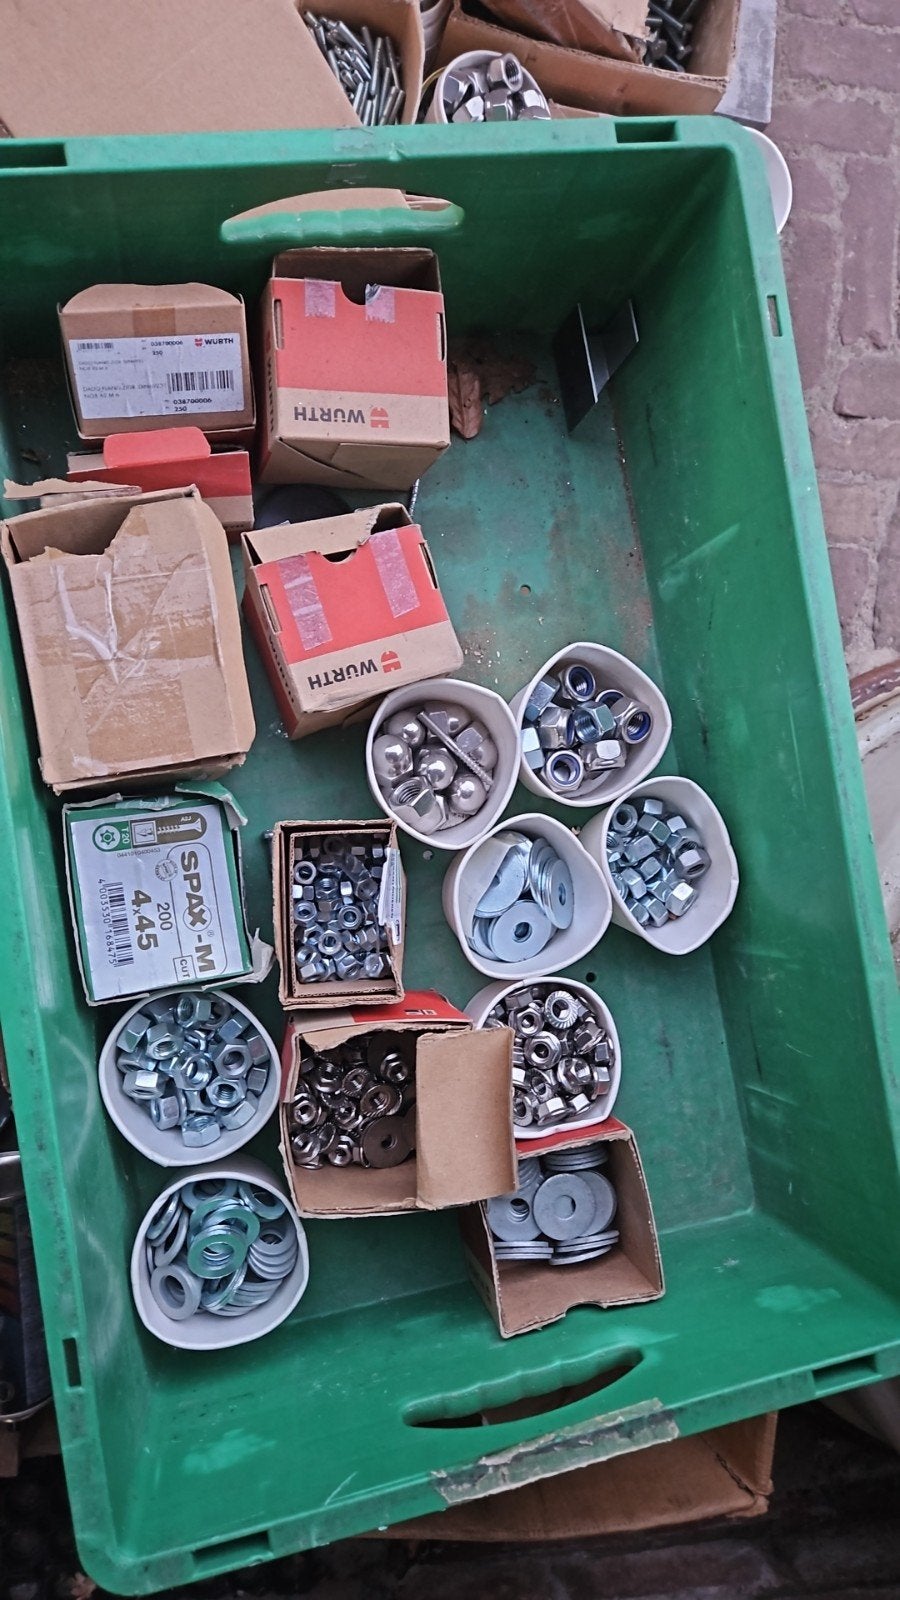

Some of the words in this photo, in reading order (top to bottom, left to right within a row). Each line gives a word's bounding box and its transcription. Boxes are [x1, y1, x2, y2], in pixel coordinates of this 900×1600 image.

[294, 406, 366, 424] WÜRTH
[307, 659, 379, 690] WÜRTH
[156, 902, 173, 931] 200
[179, 958, 191, 978] CUT
